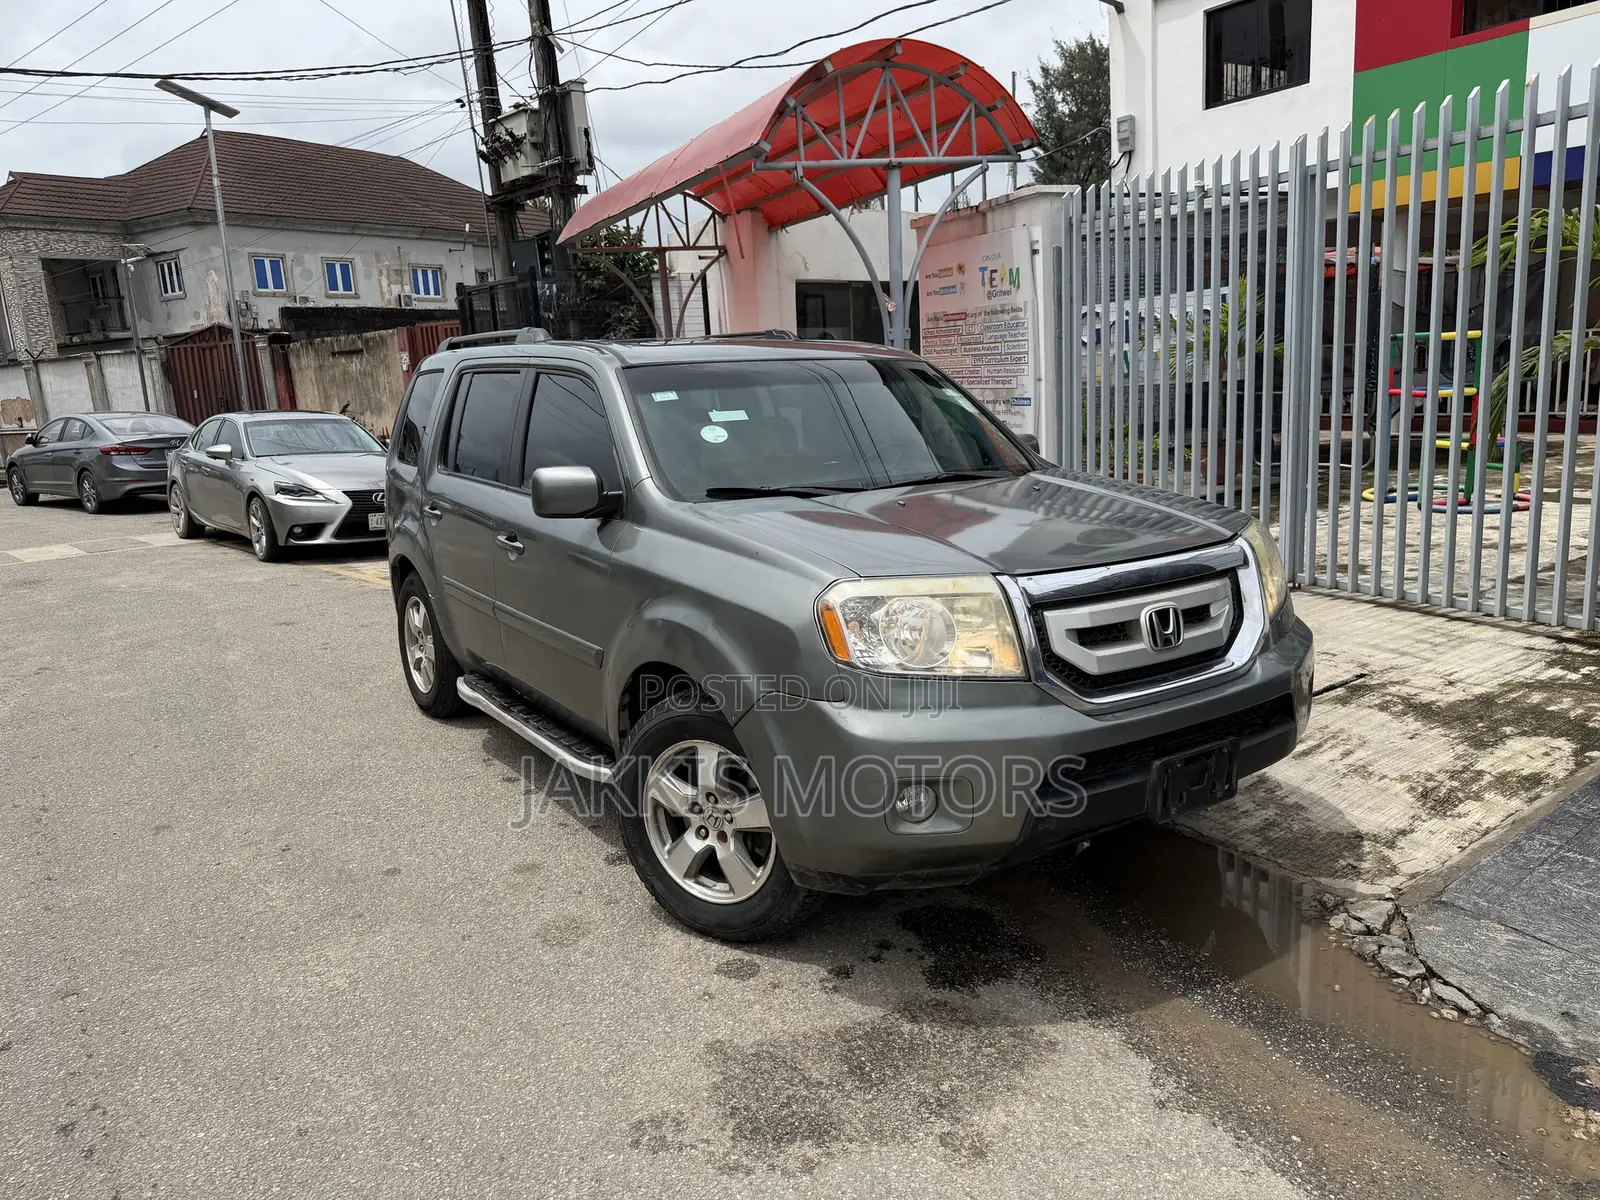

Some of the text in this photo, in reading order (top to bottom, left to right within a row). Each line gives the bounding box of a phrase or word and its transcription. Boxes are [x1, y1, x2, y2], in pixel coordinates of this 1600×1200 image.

[978, 263, 1020, 289] TEAM
[980, 320, 1026, 331] Classroom Educator
[986, 331, 1027, 341] Language Teacher
[981, 345, 1000, 353] Analysts
[1006, 342, 1027, 350] Scientist
[985, 356, 1009, 364] Curriculum
[1010, 355, 1026, 363] Expert
[1003, 367, 1025, 375] Resource
[966, 379, 990, 387] Specialized
[991, 378, 1012, 387] Therapist
[1011, 398, 1031, 406] Children
